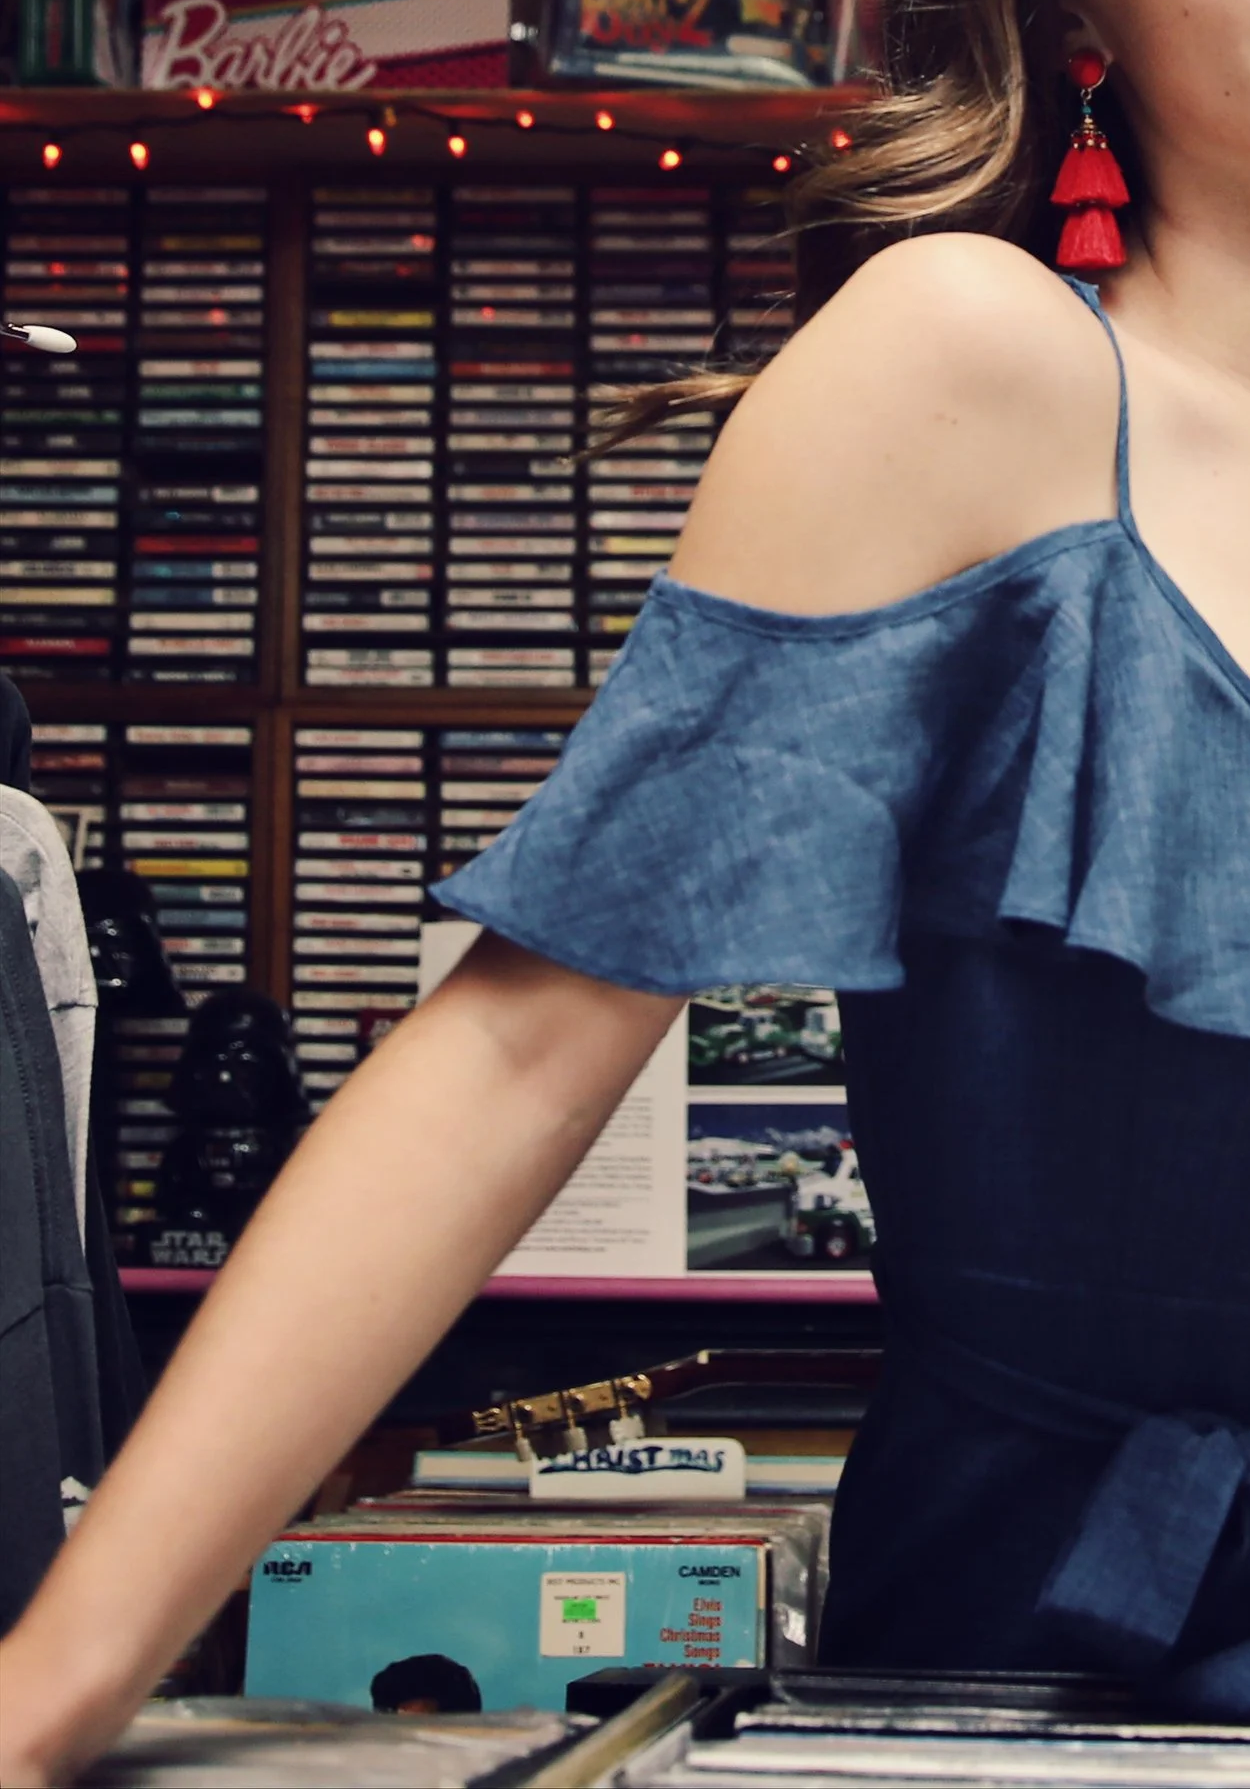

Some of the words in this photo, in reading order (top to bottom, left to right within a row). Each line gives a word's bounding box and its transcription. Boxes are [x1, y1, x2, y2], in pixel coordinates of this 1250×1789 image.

[262, 1559, 313, 1576] RCA
[678, 1565, 741, 1578] CAMDEN
[693, 1598, 723, 1612] Elvis
[688, 1613, 722, 1629] Sings
[660, 1628, 722, 1642] Christmas
[684, 1644, 721, 1661] Songs
